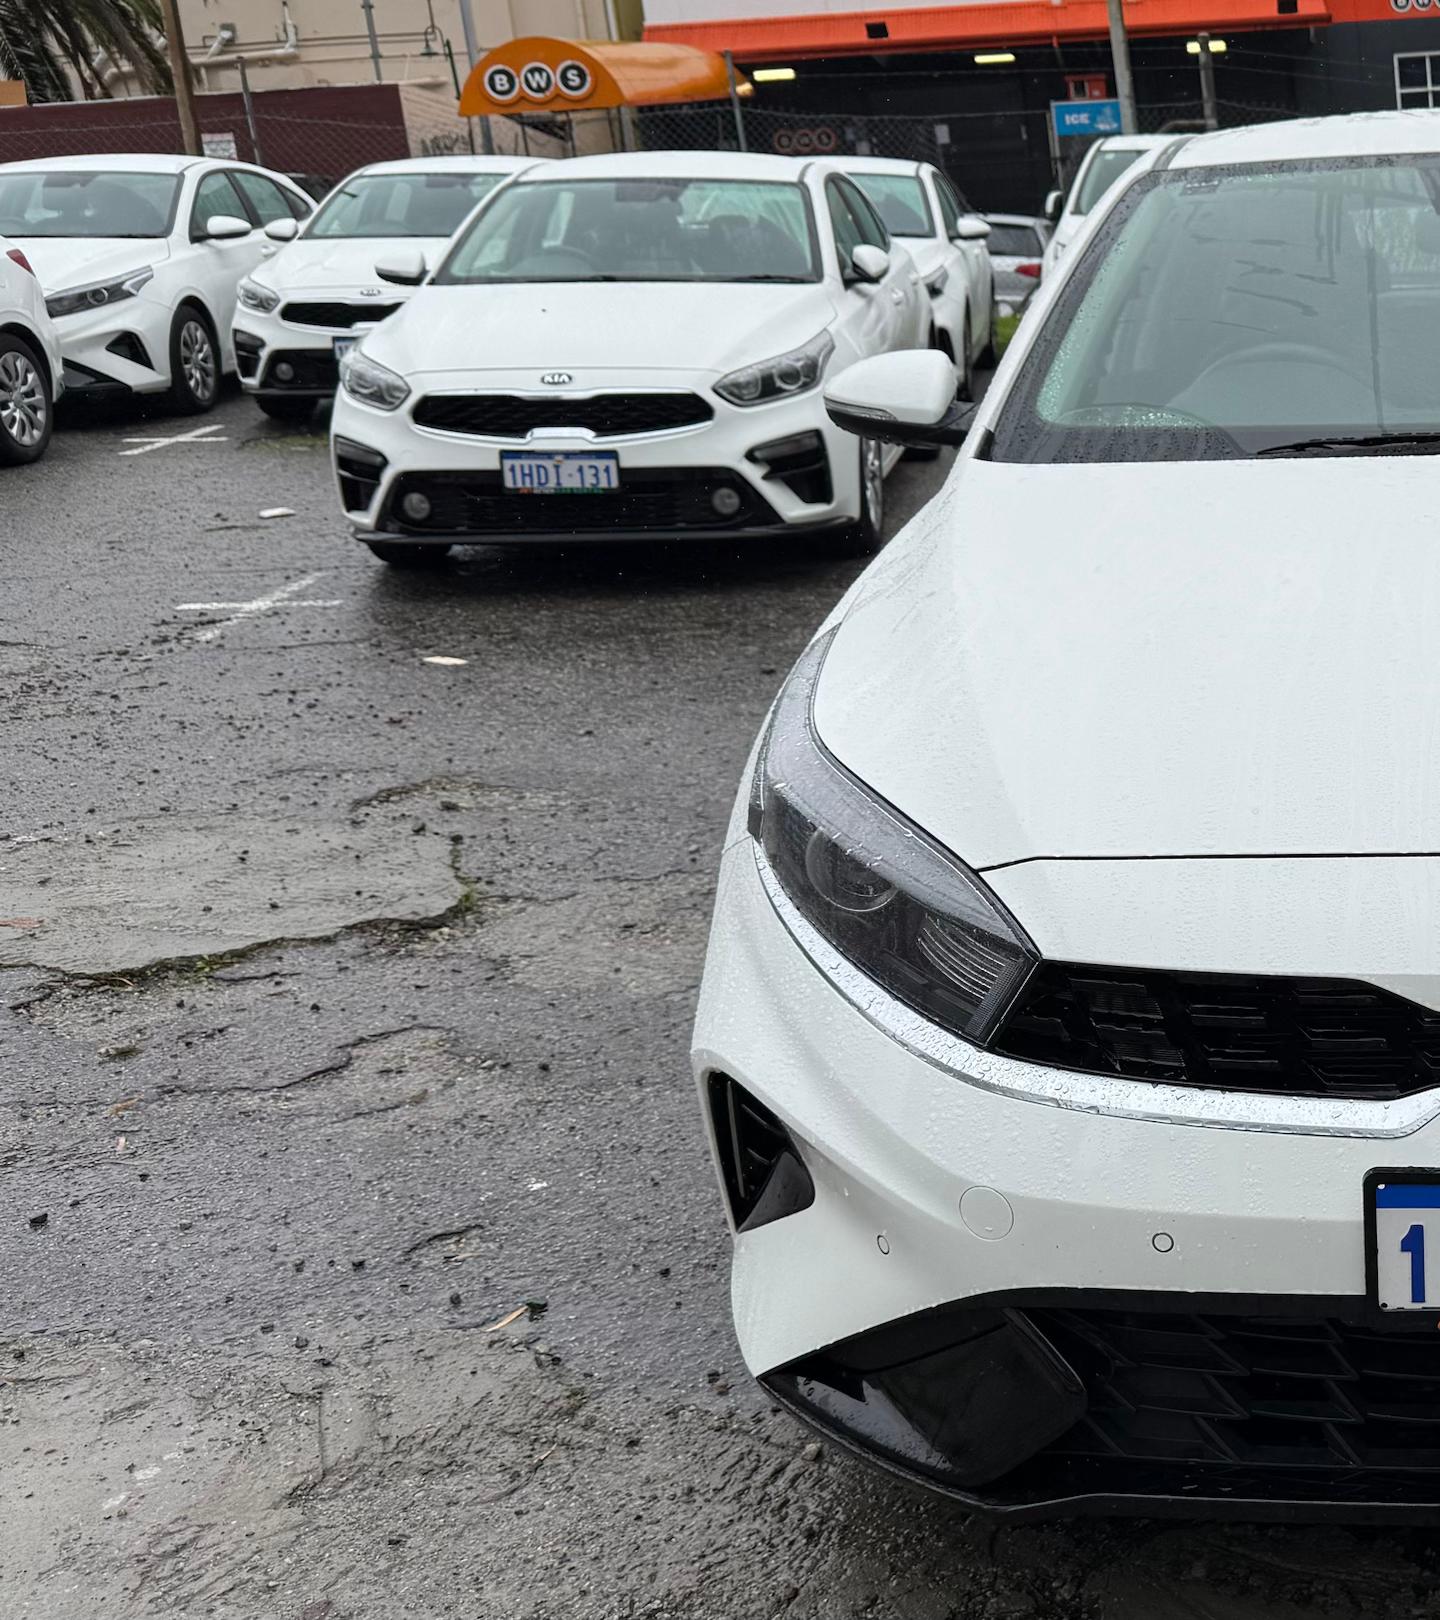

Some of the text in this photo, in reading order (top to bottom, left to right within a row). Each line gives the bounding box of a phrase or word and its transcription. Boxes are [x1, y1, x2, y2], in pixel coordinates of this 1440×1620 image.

[490, 67, 583, 93] BWS
[1064, 113, 1089, 125] ICE
[541, 373, 573, 385] KIA
